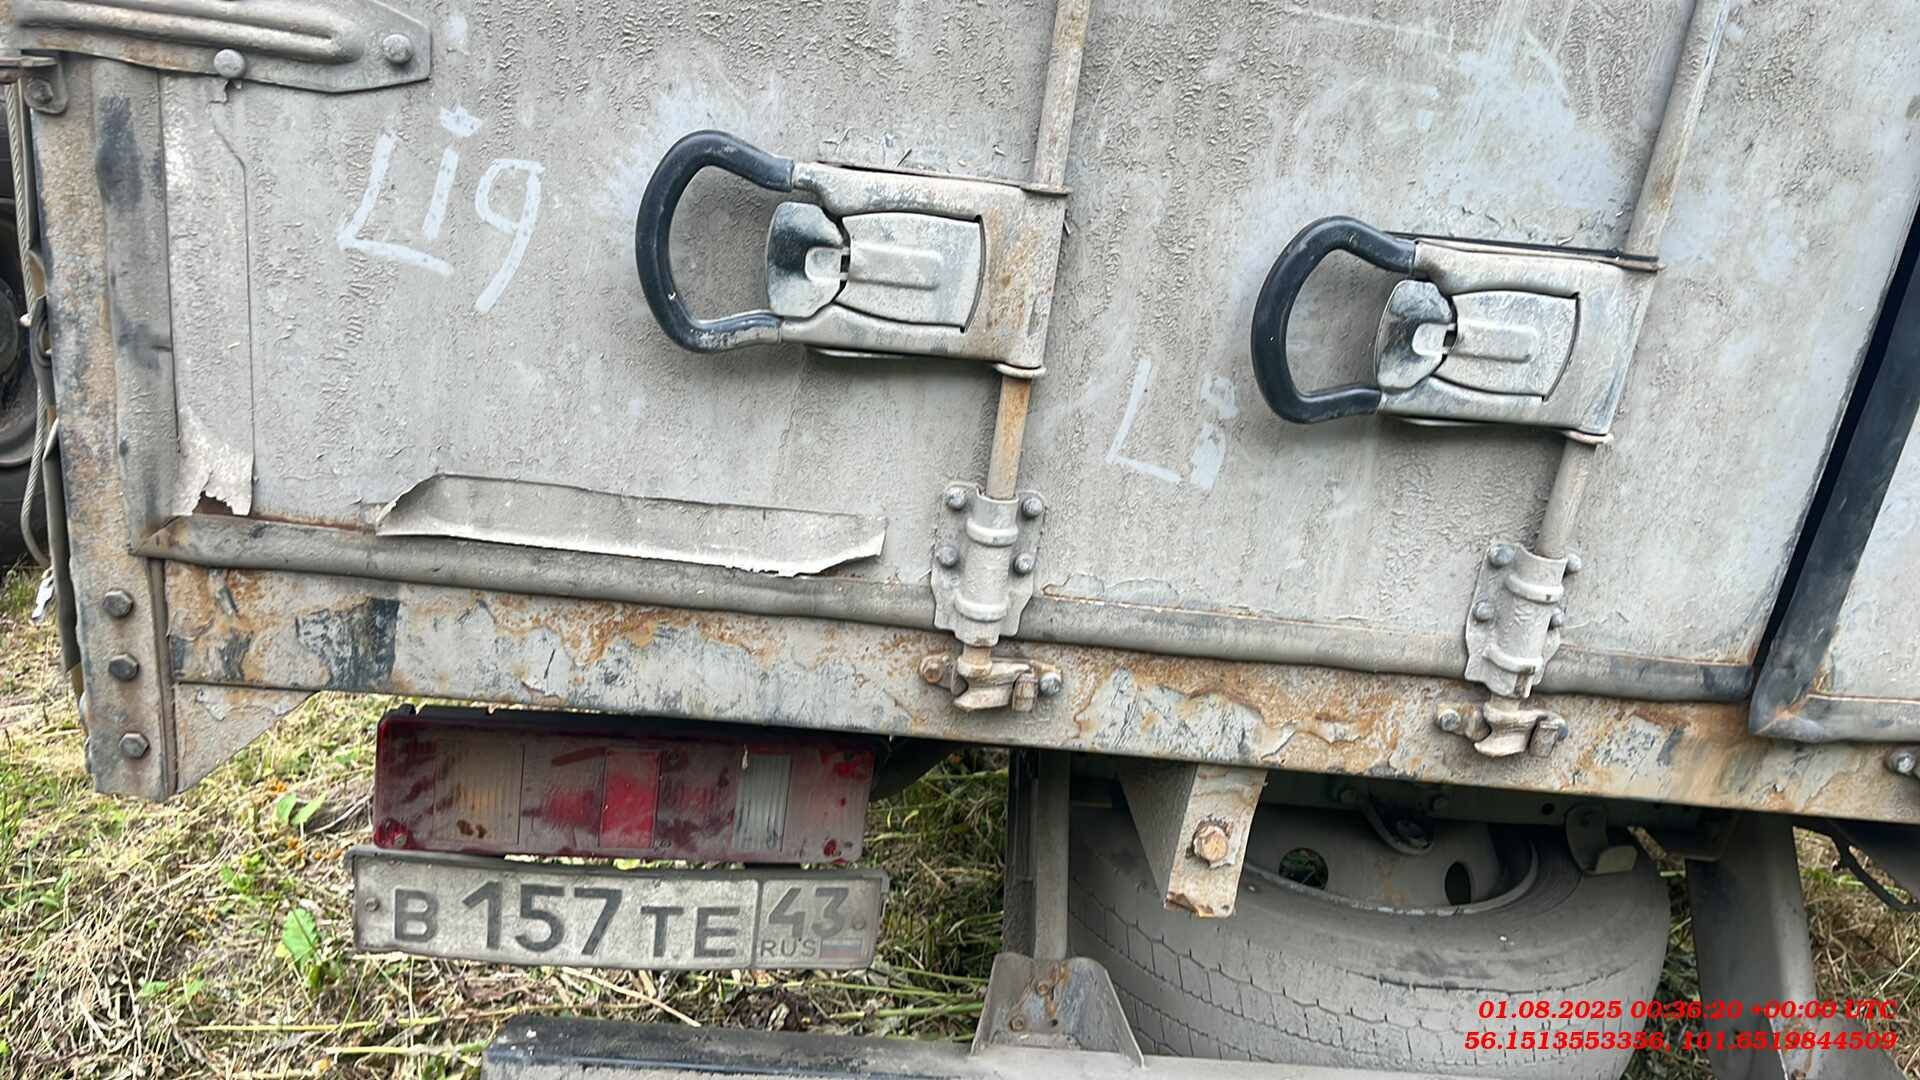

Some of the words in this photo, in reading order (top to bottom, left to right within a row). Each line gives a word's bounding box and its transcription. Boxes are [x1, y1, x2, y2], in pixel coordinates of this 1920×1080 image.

[461, 881, 623, 956] 157
[768, 887, 849, 938] 43
[760, 939, 817, 958] RUS
